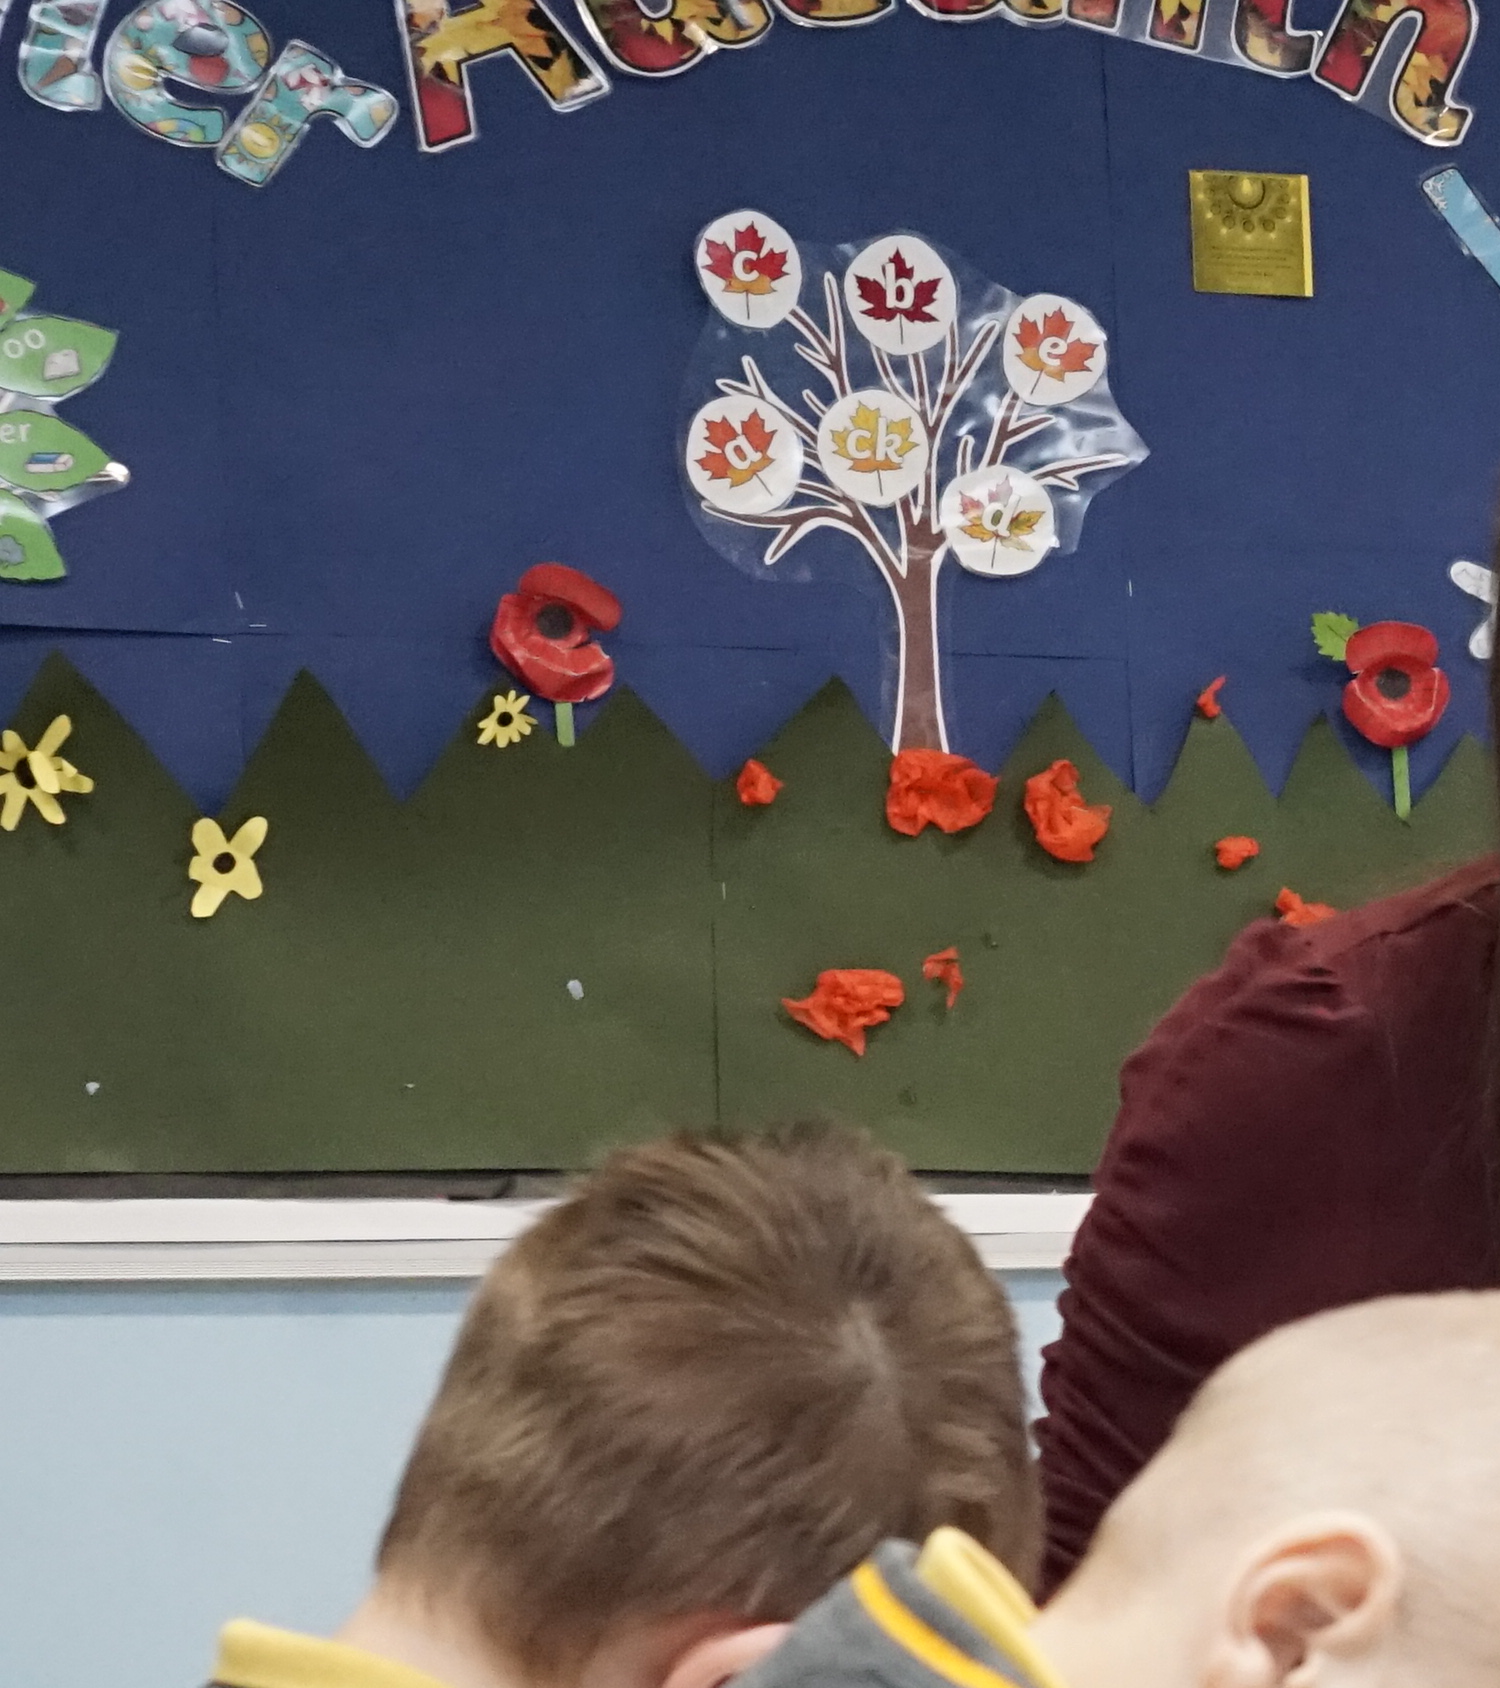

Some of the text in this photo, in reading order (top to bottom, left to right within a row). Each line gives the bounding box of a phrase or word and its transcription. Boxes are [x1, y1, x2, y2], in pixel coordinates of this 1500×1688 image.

[733, 251, 758, 283] c
[884, 263, 913, 308] b
[1038, 334, 1068, 366] e
[726, 433, 761, 470] a
[846, 416, 904, 463] ck
[982, 496, 1013, 538] d
